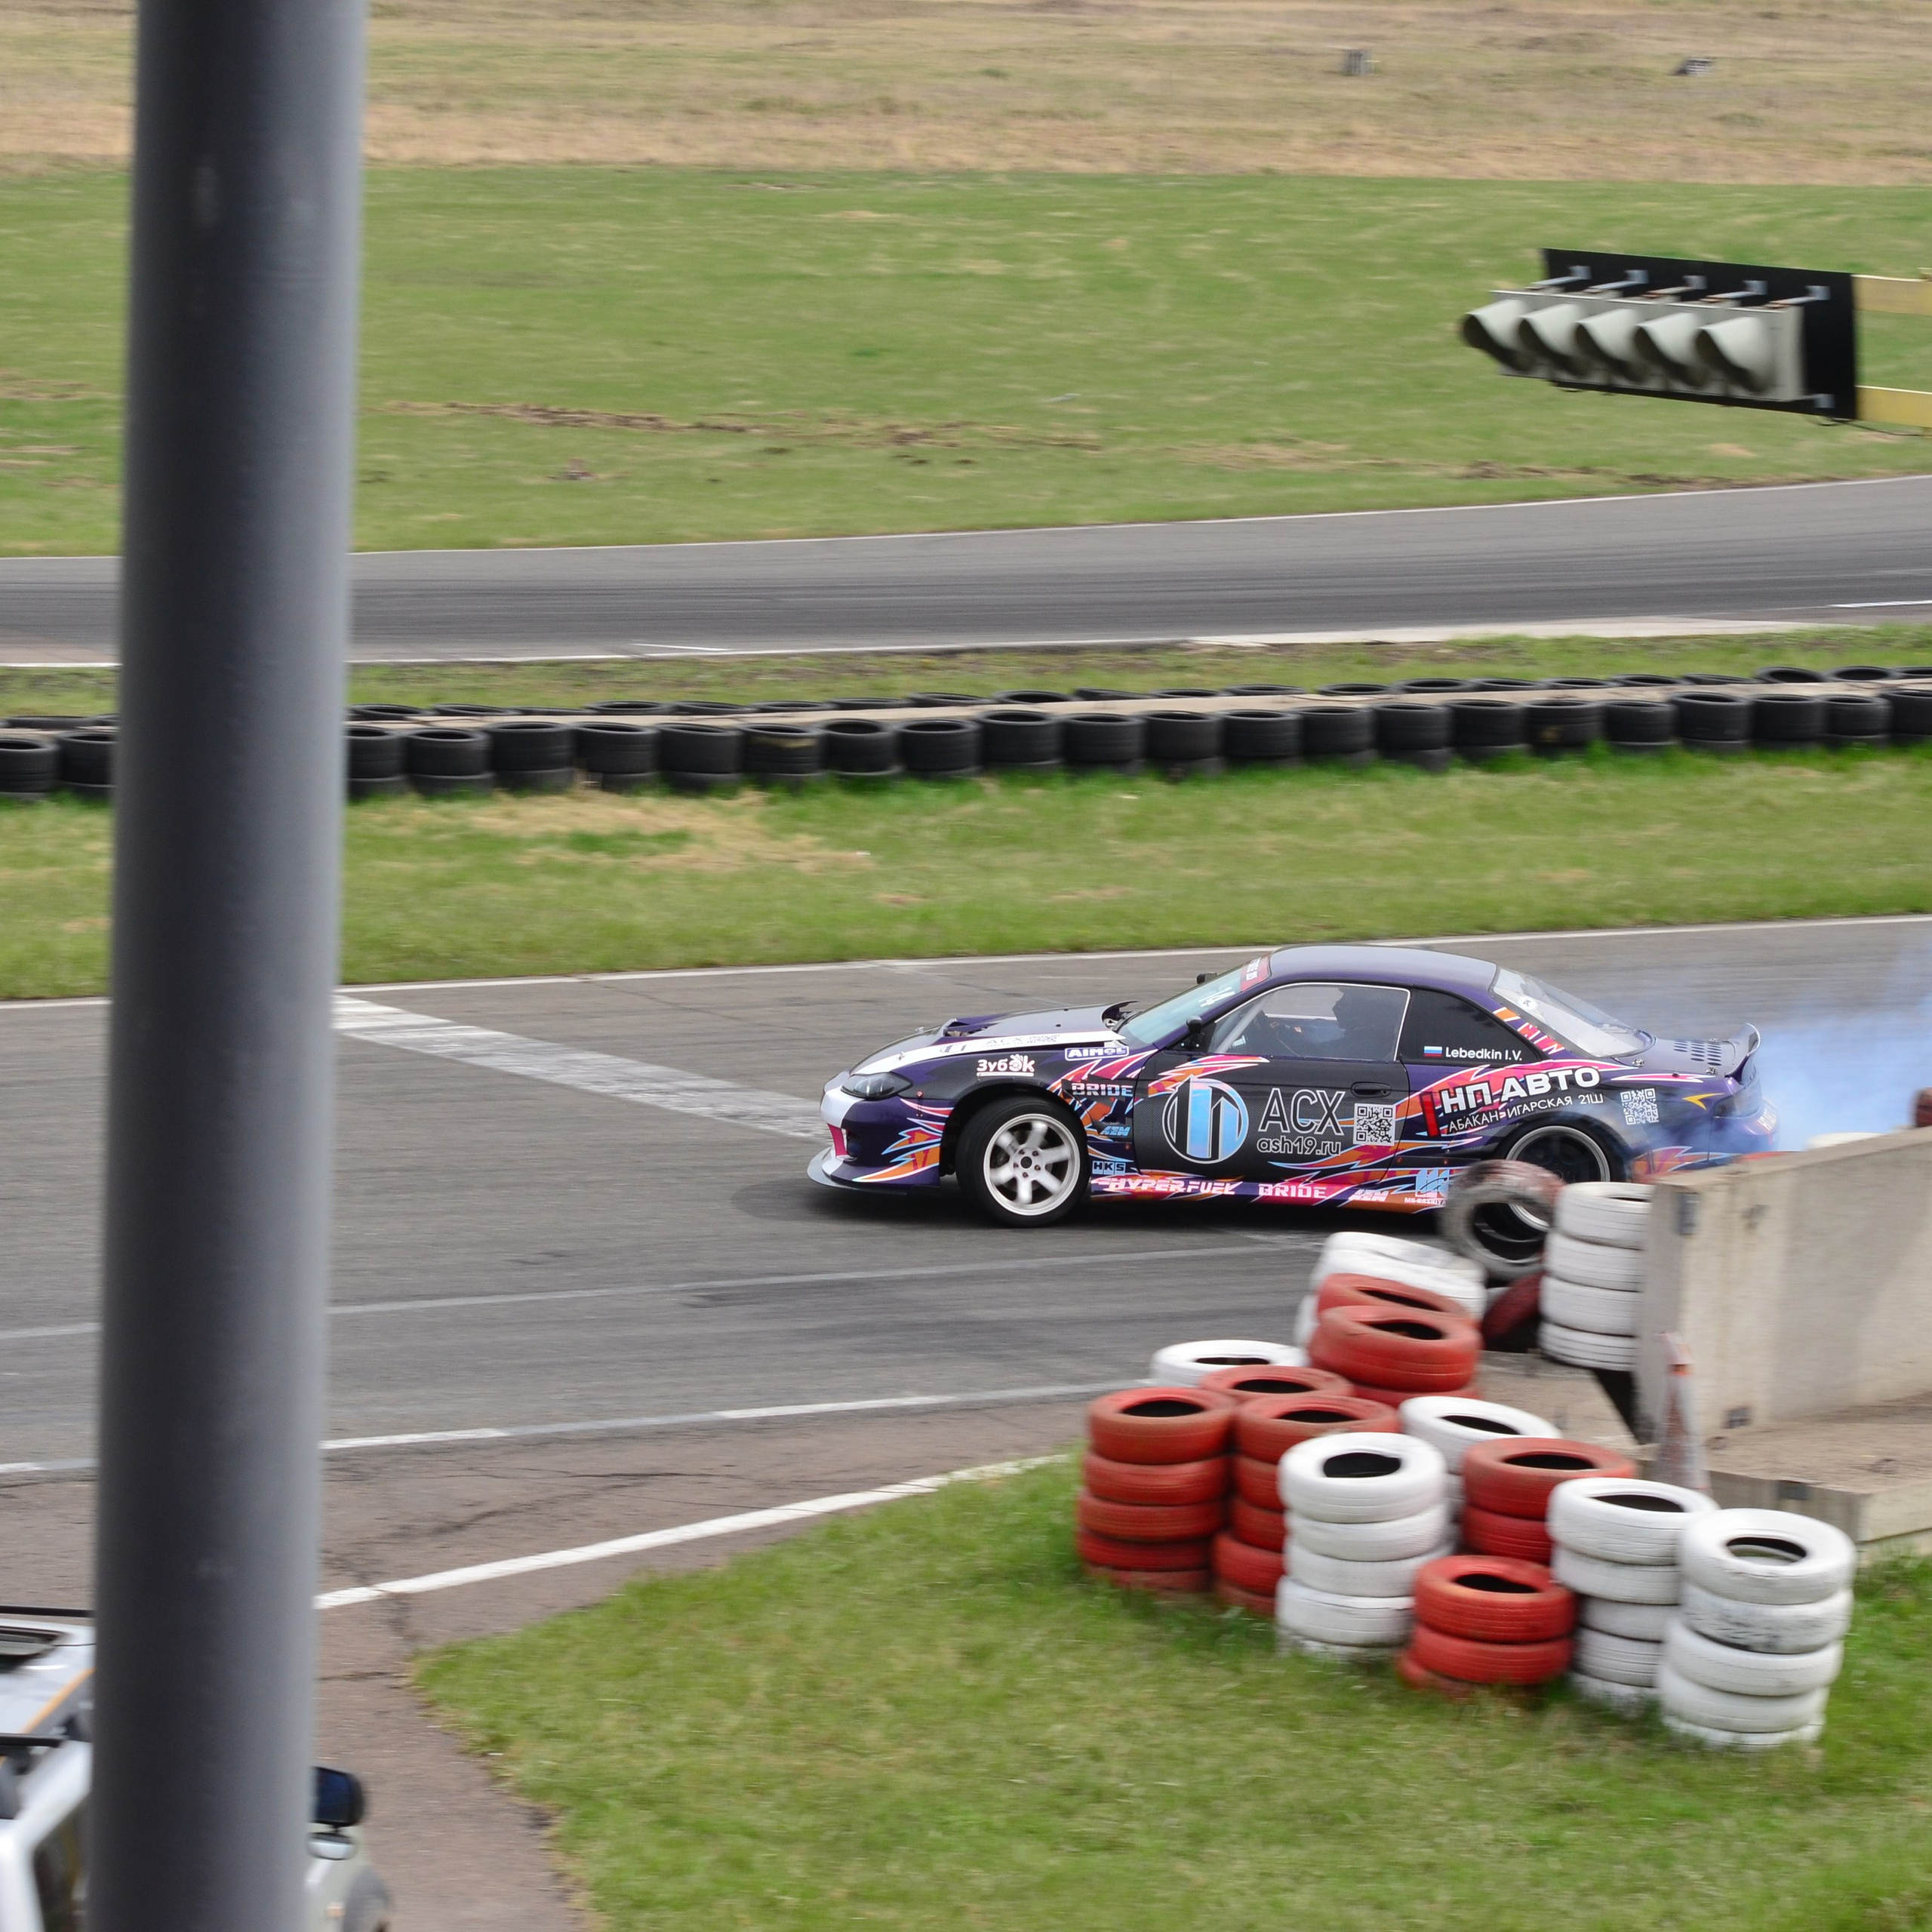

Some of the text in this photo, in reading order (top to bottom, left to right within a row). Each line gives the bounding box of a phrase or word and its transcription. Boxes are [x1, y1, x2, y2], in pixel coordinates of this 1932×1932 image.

[1445, 1047, 1523, 1061] Lebedkin I.V.
[1072, 1082, 1134, 1097] BRIDE
[1441, 1066, 1601, 1114] НП АВТО
[1257, 1088, 1346, 1136] АСХ
[1449, 1093, 1604, 1132] АБАКАН ИГАРСКАЯ 21Ш
[1257, 1136, 1342, 1156] ash19.ru
[1093, 1161, 1125, 1172] HKS
[1102, 1177, 1242, 1195] HYPER FUEL
[1258, 1183, 1327, 1198] BRIDE
